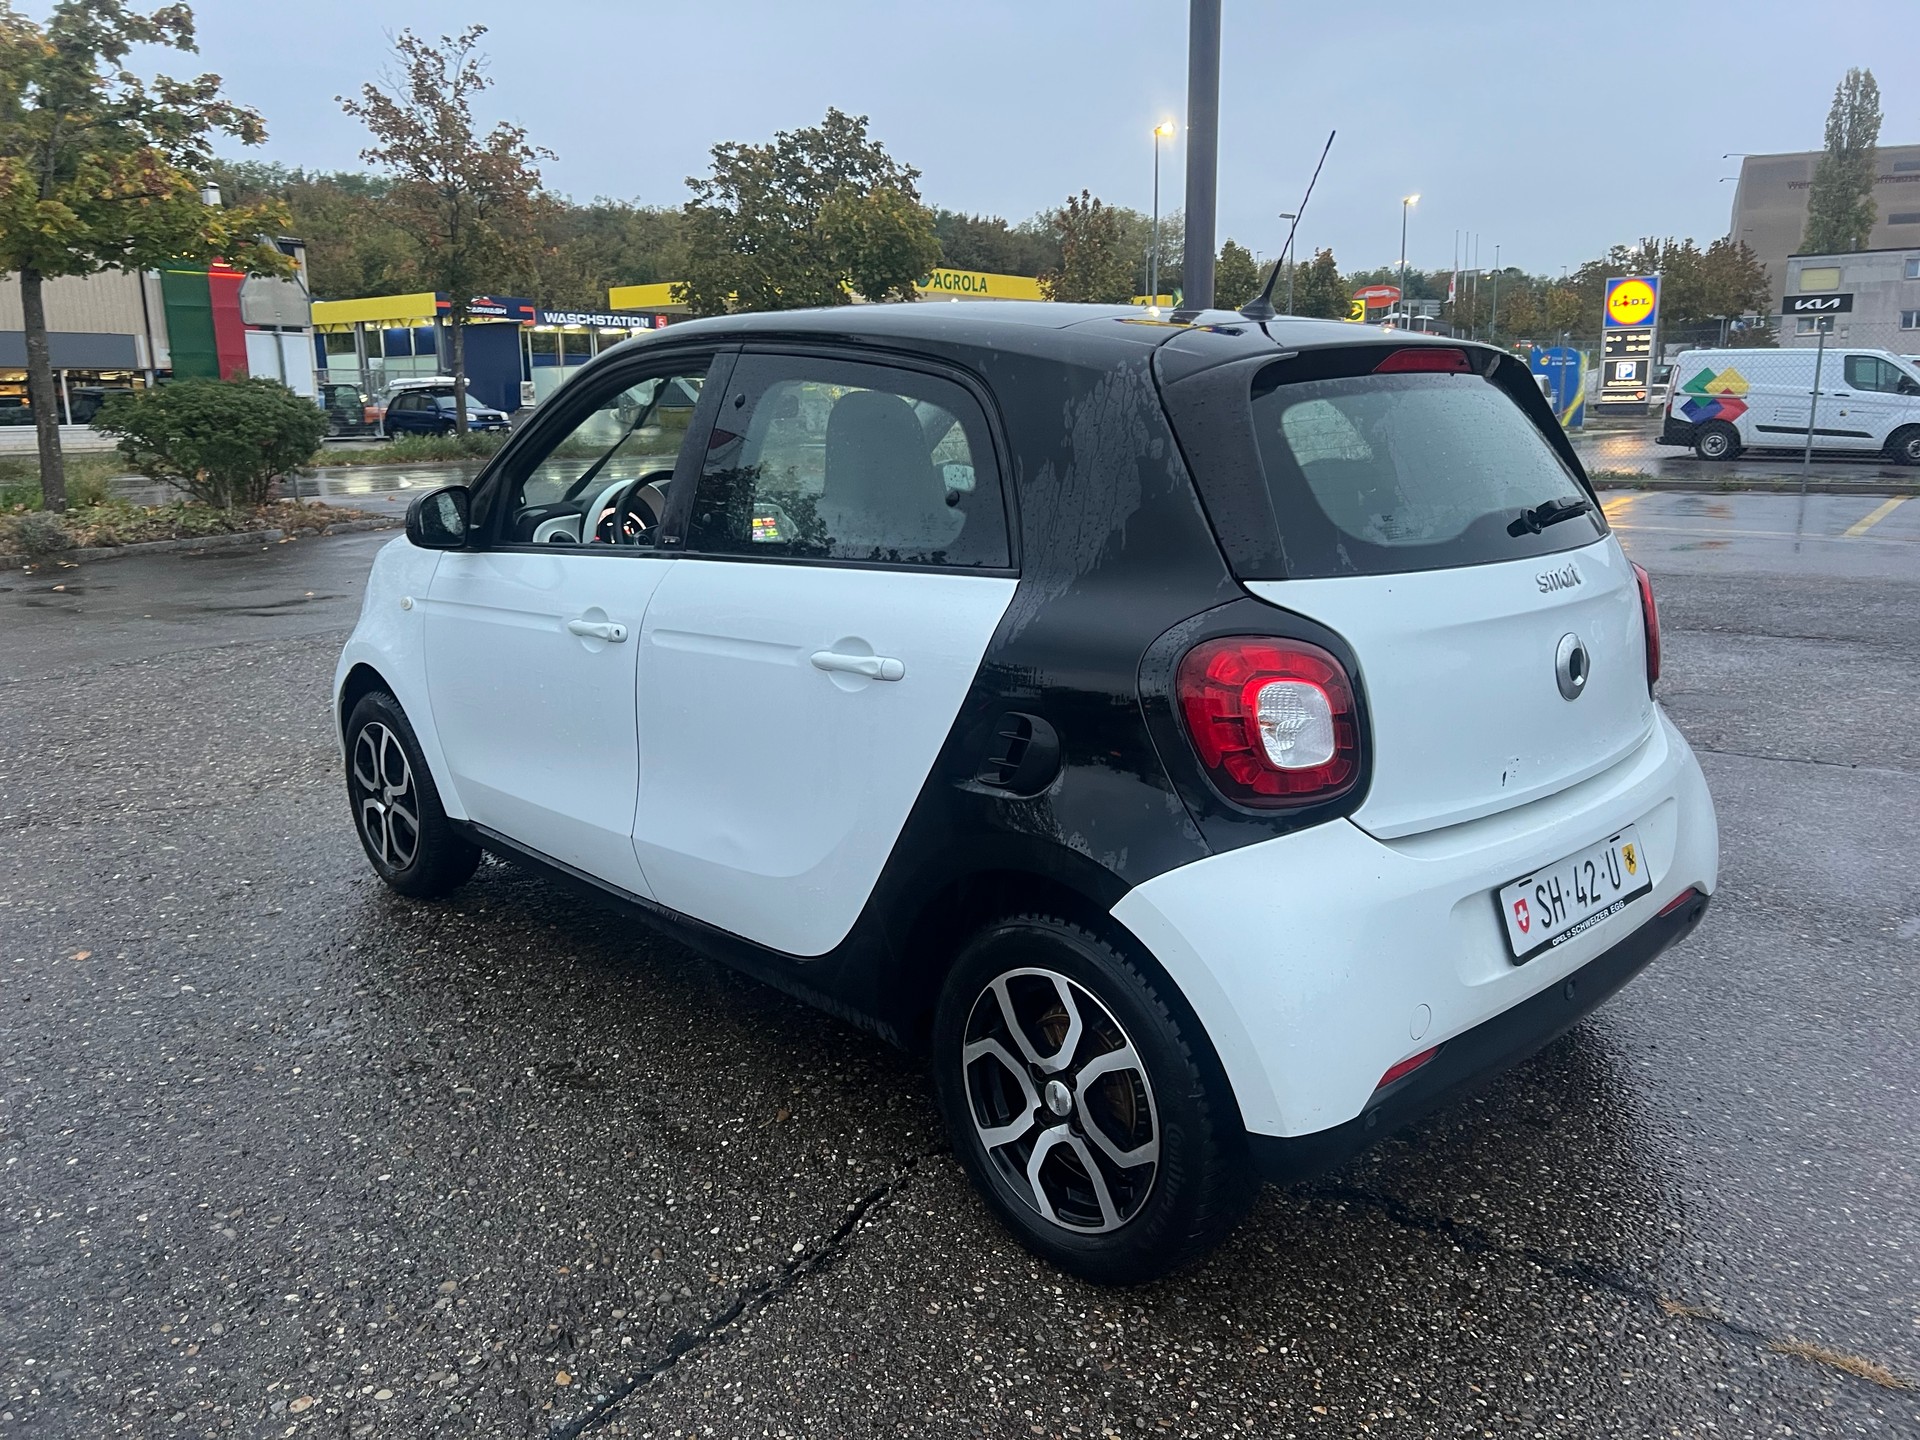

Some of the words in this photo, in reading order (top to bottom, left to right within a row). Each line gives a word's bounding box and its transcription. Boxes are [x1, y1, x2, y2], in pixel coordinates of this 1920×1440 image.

[933, 272, 988, 293] AGROLA
[1794, 298, 1841, 310] KIA
[543, 312, 650, 328] WASCHSTATION
[658, 318, 665, 328] 5
[1535, 563, 1582, 593] smart
[1552, 934, 1568, 946] OPEL
[1571, 909, 1610, 936] SCHWEIZER
[1610, 900, 1625, 914] EGG
